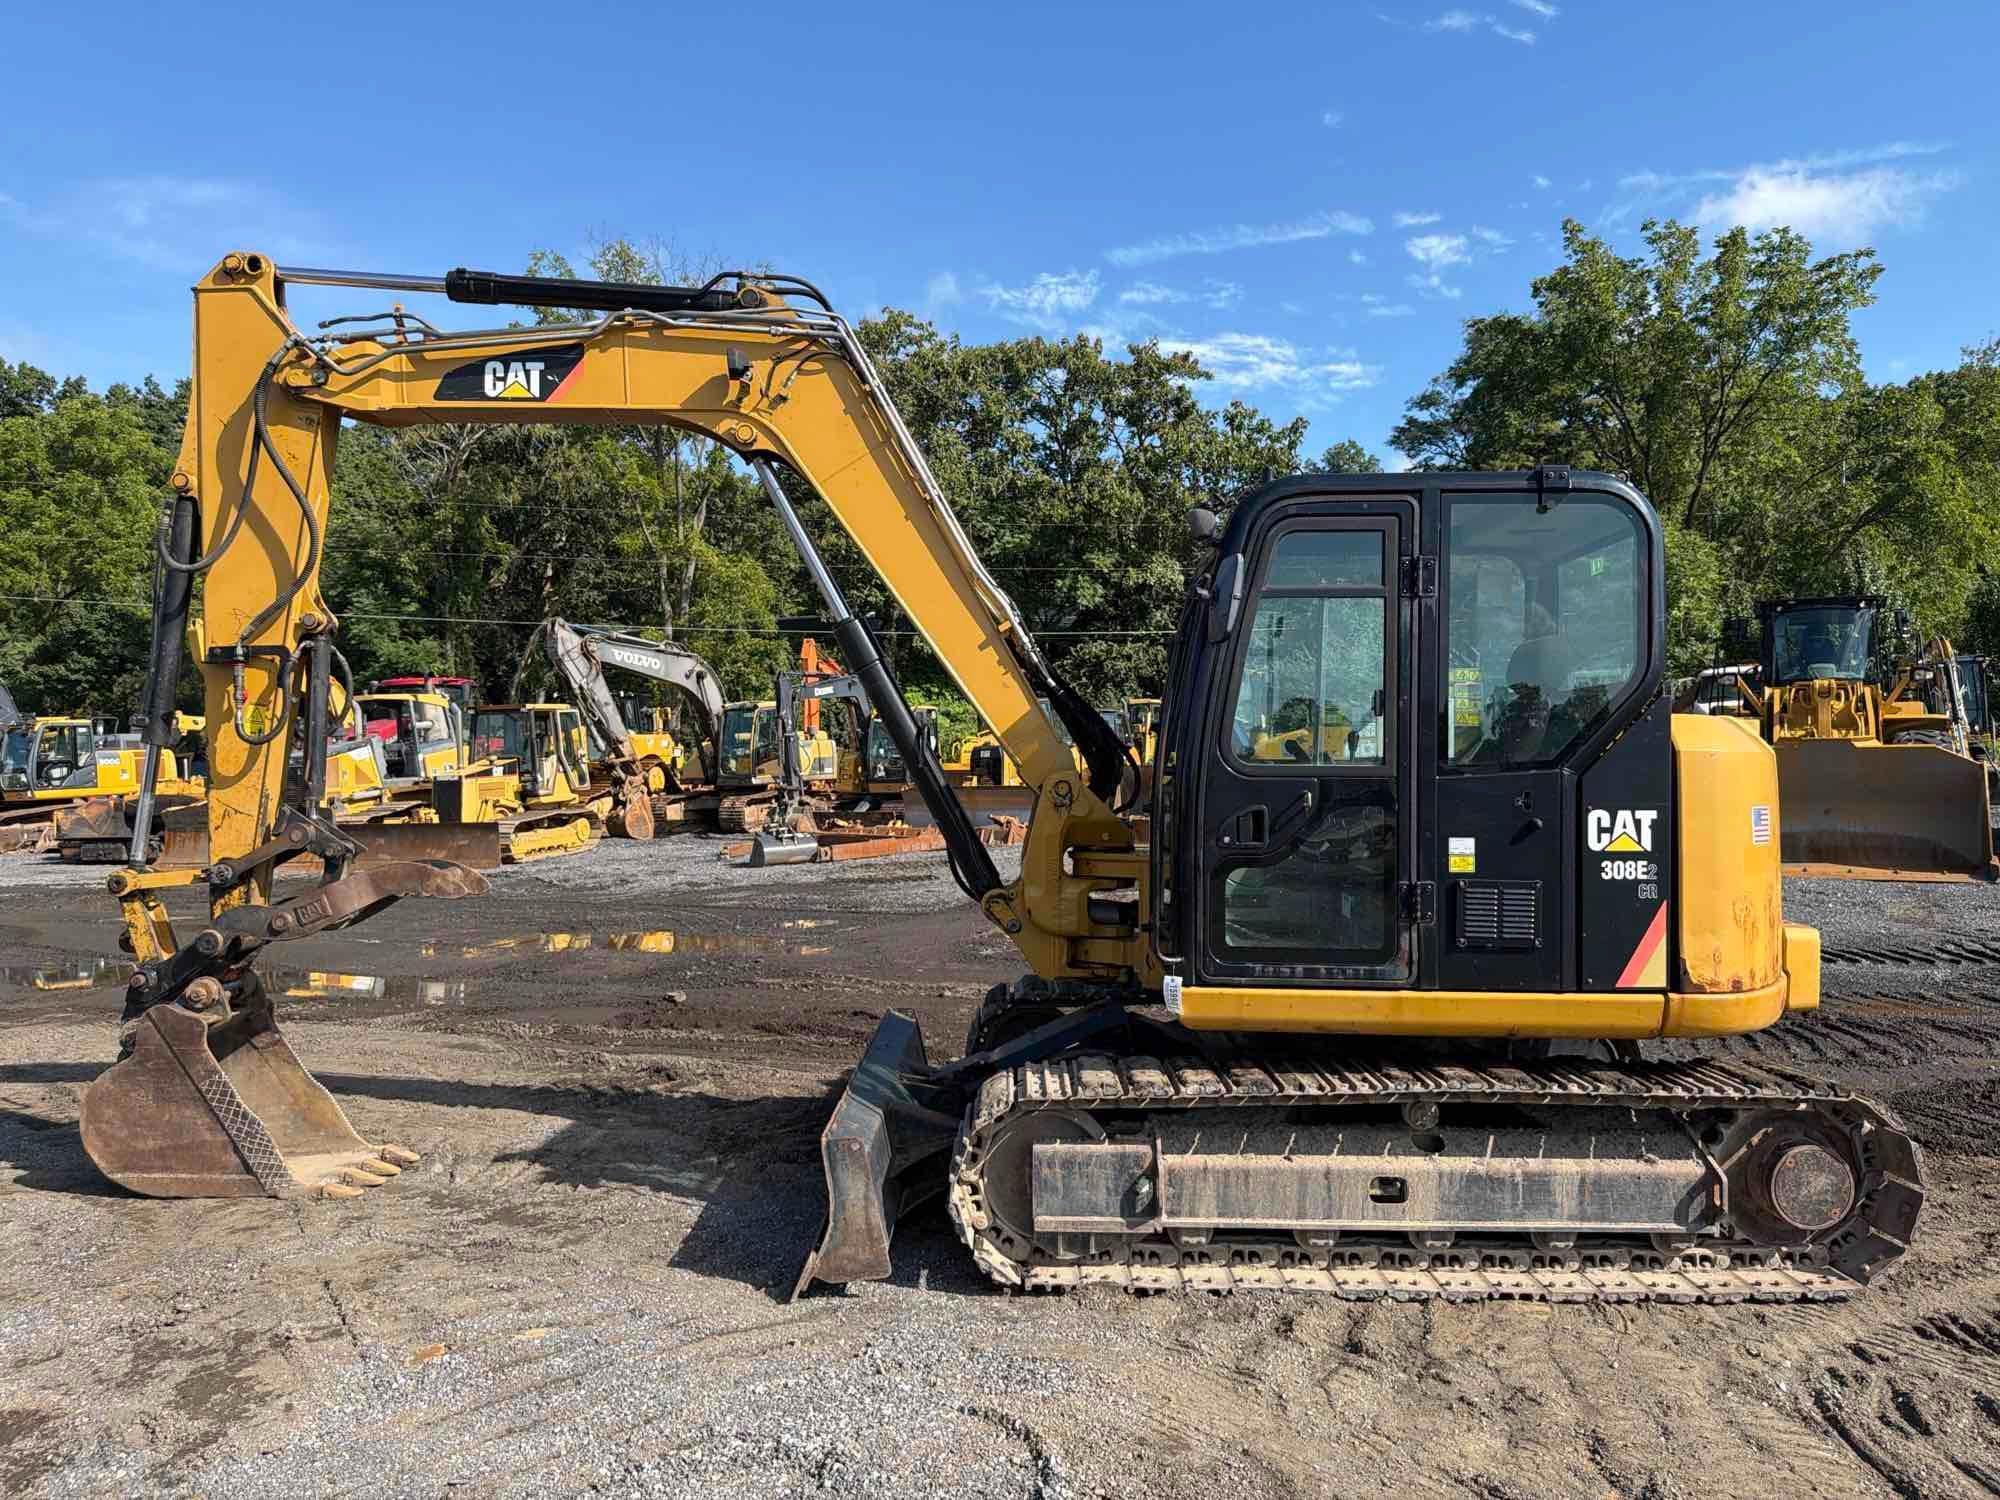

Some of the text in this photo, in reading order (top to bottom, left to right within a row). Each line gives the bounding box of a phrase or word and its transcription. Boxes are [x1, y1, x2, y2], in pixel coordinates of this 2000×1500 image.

[483, 361, 545, 399] CAT
[612, 649, 661, 669] VOLVO
[1587, 808, 1658, 853] CAT
[1600, 859, 1658, 880] 308E2
[1638, 884, 1658, 898] CR
